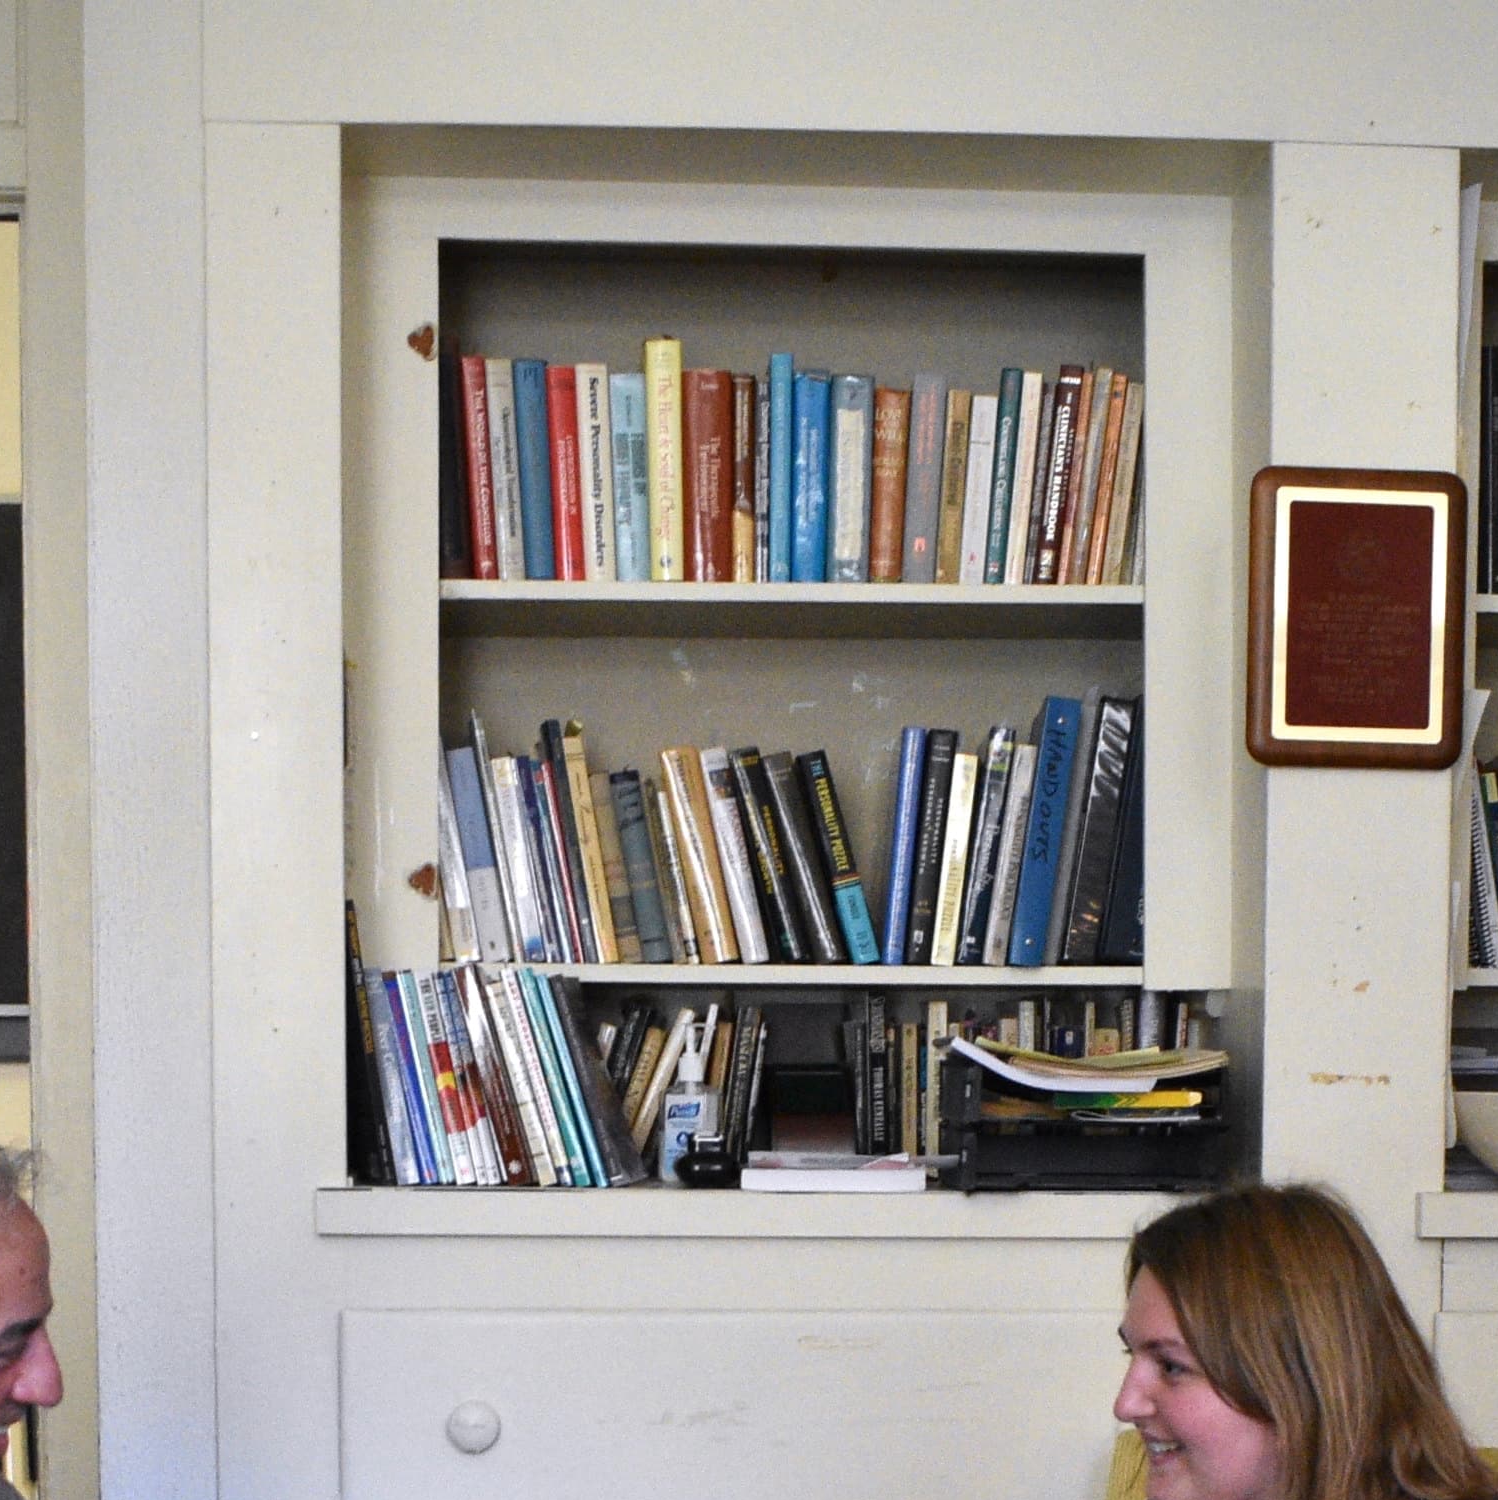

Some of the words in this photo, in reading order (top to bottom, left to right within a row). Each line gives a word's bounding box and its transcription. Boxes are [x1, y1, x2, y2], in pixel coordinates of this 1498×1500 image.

[589, 376, 600, 421] Severe
[658, 375, 674, 397] The
[658, 401, 673, 434] Heart
[1054, 405, 1072, 473] CLINICIAN'S
[590, 423, 605, 501] Personality
[658, 452, 674, 480] Soul
[1045, 475, 1063, 542] HANDBOOK
[594, 503, 607, 568] Disorders
[809, 759, 825, 778] THE
[1042, 727, 1068, 798] HAND
[814, 777, 842, 838] PERSONALITY
[830, 838, 851, 873] PUZZLE
